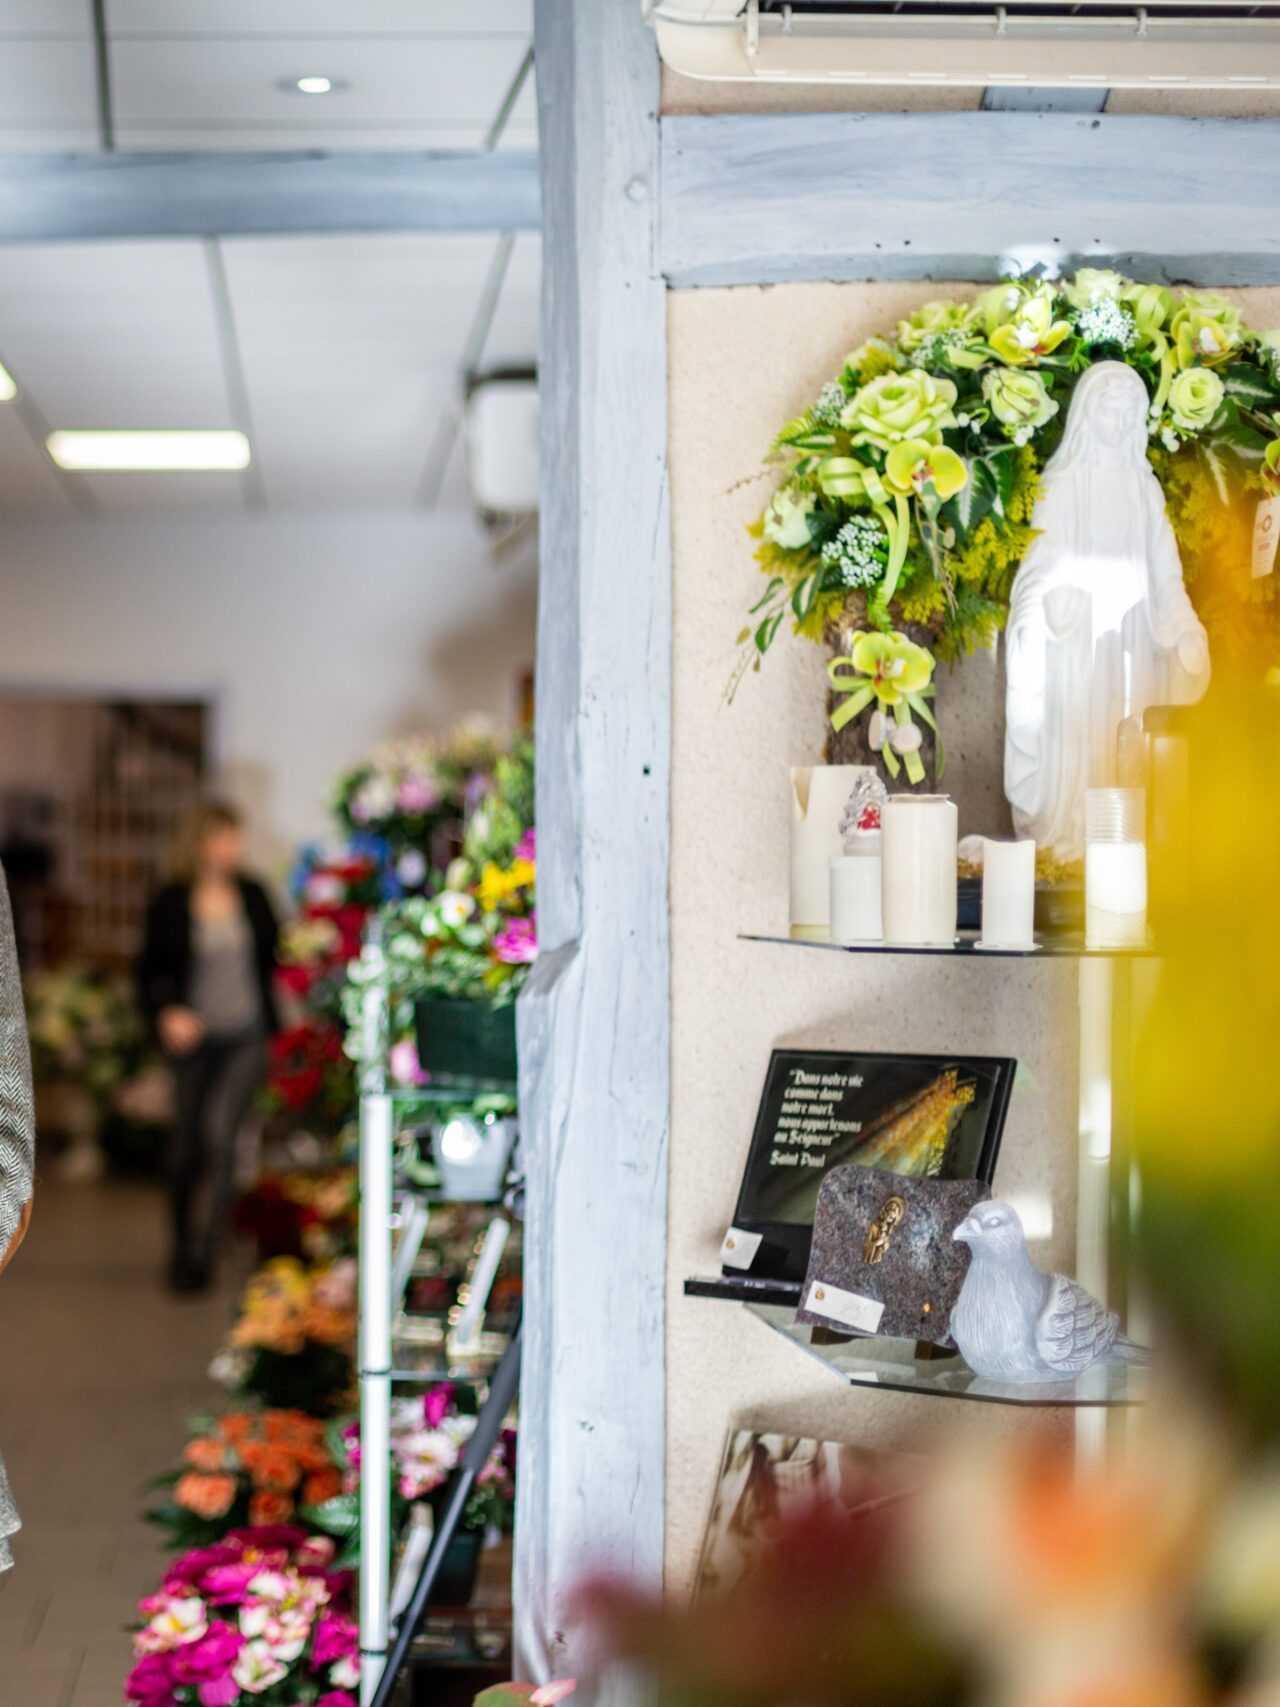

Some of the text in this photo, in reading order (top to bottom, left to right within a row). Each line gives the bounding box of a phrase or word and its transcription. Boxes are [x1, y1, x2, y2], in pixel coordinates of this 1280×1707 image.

[821, 1072, 847, 1086] notre
[848, 1074, 863, 1087] vie
[784, 1087, 843, 1101] comme dans
[781, 1101, 807, 1114] notre
[777, 1117, 862, 1133] nous appartenons
[773, 1132, 788, 1143] au
[769, 1150, 825, 1167] Saint Paul
